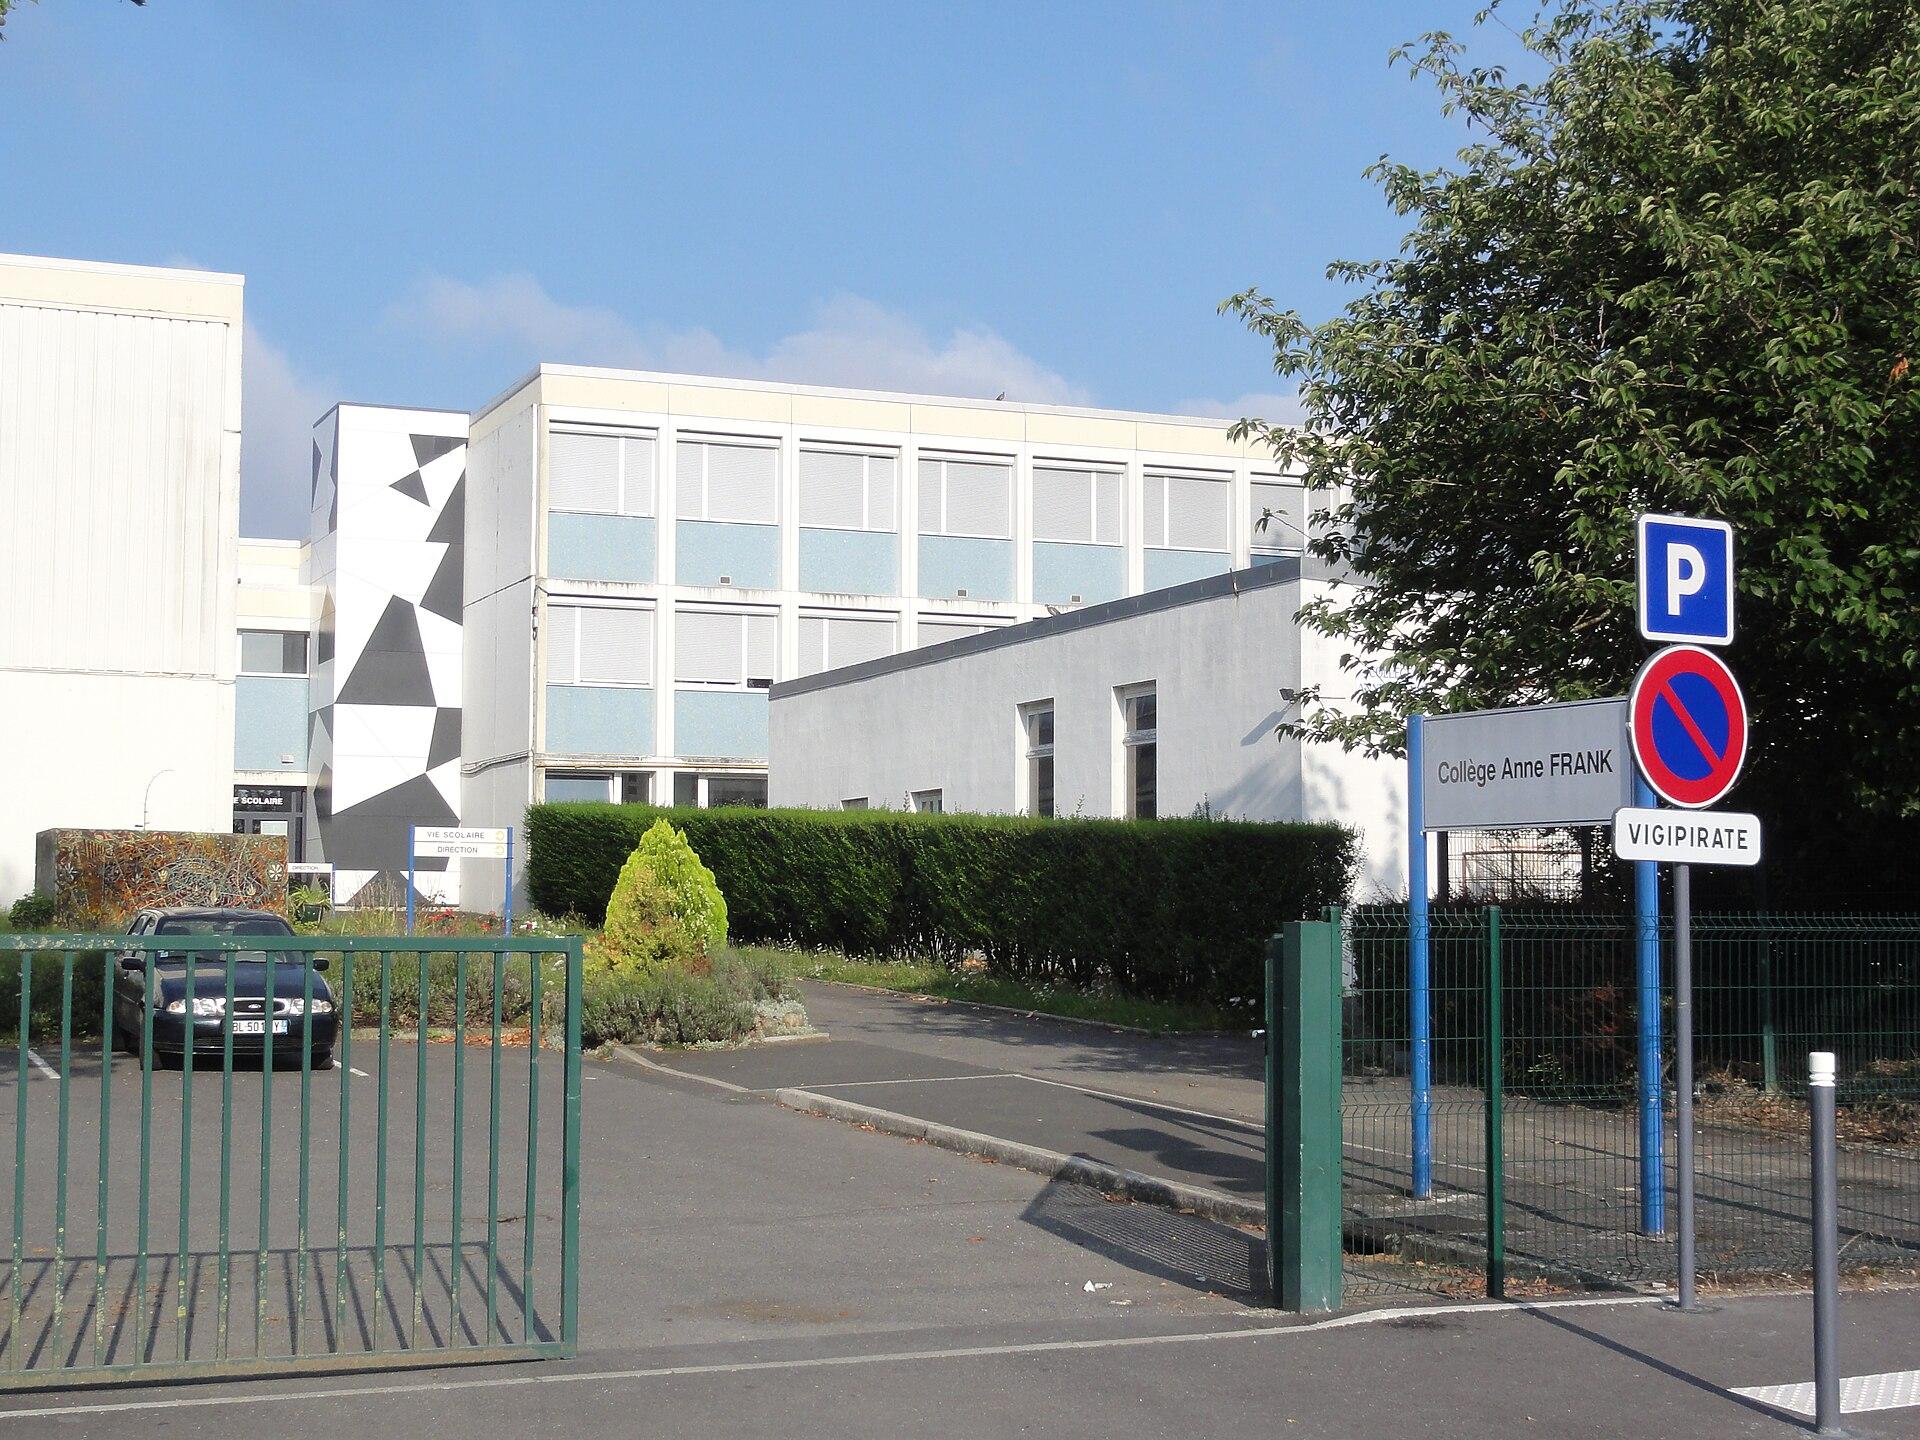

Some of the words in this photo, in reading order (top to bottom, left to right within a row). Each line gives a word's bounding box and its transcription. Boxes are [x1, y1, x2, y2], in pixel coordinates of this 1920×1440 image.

[1666, 542, 1706, 616] P
[1438, 758, 1496, 788] Collège
[1501, 757, 1544, 780] Anne
[1550, 749, 1613, 777] FRANK
[241, 797, 284, 805] SCOLAIRE
[443, 831, 485, 839] SCOLAIRE
[1628, 822, 1748, 850] VIGIPIRATE
[437, 846, 478, 854] DIRECTION
